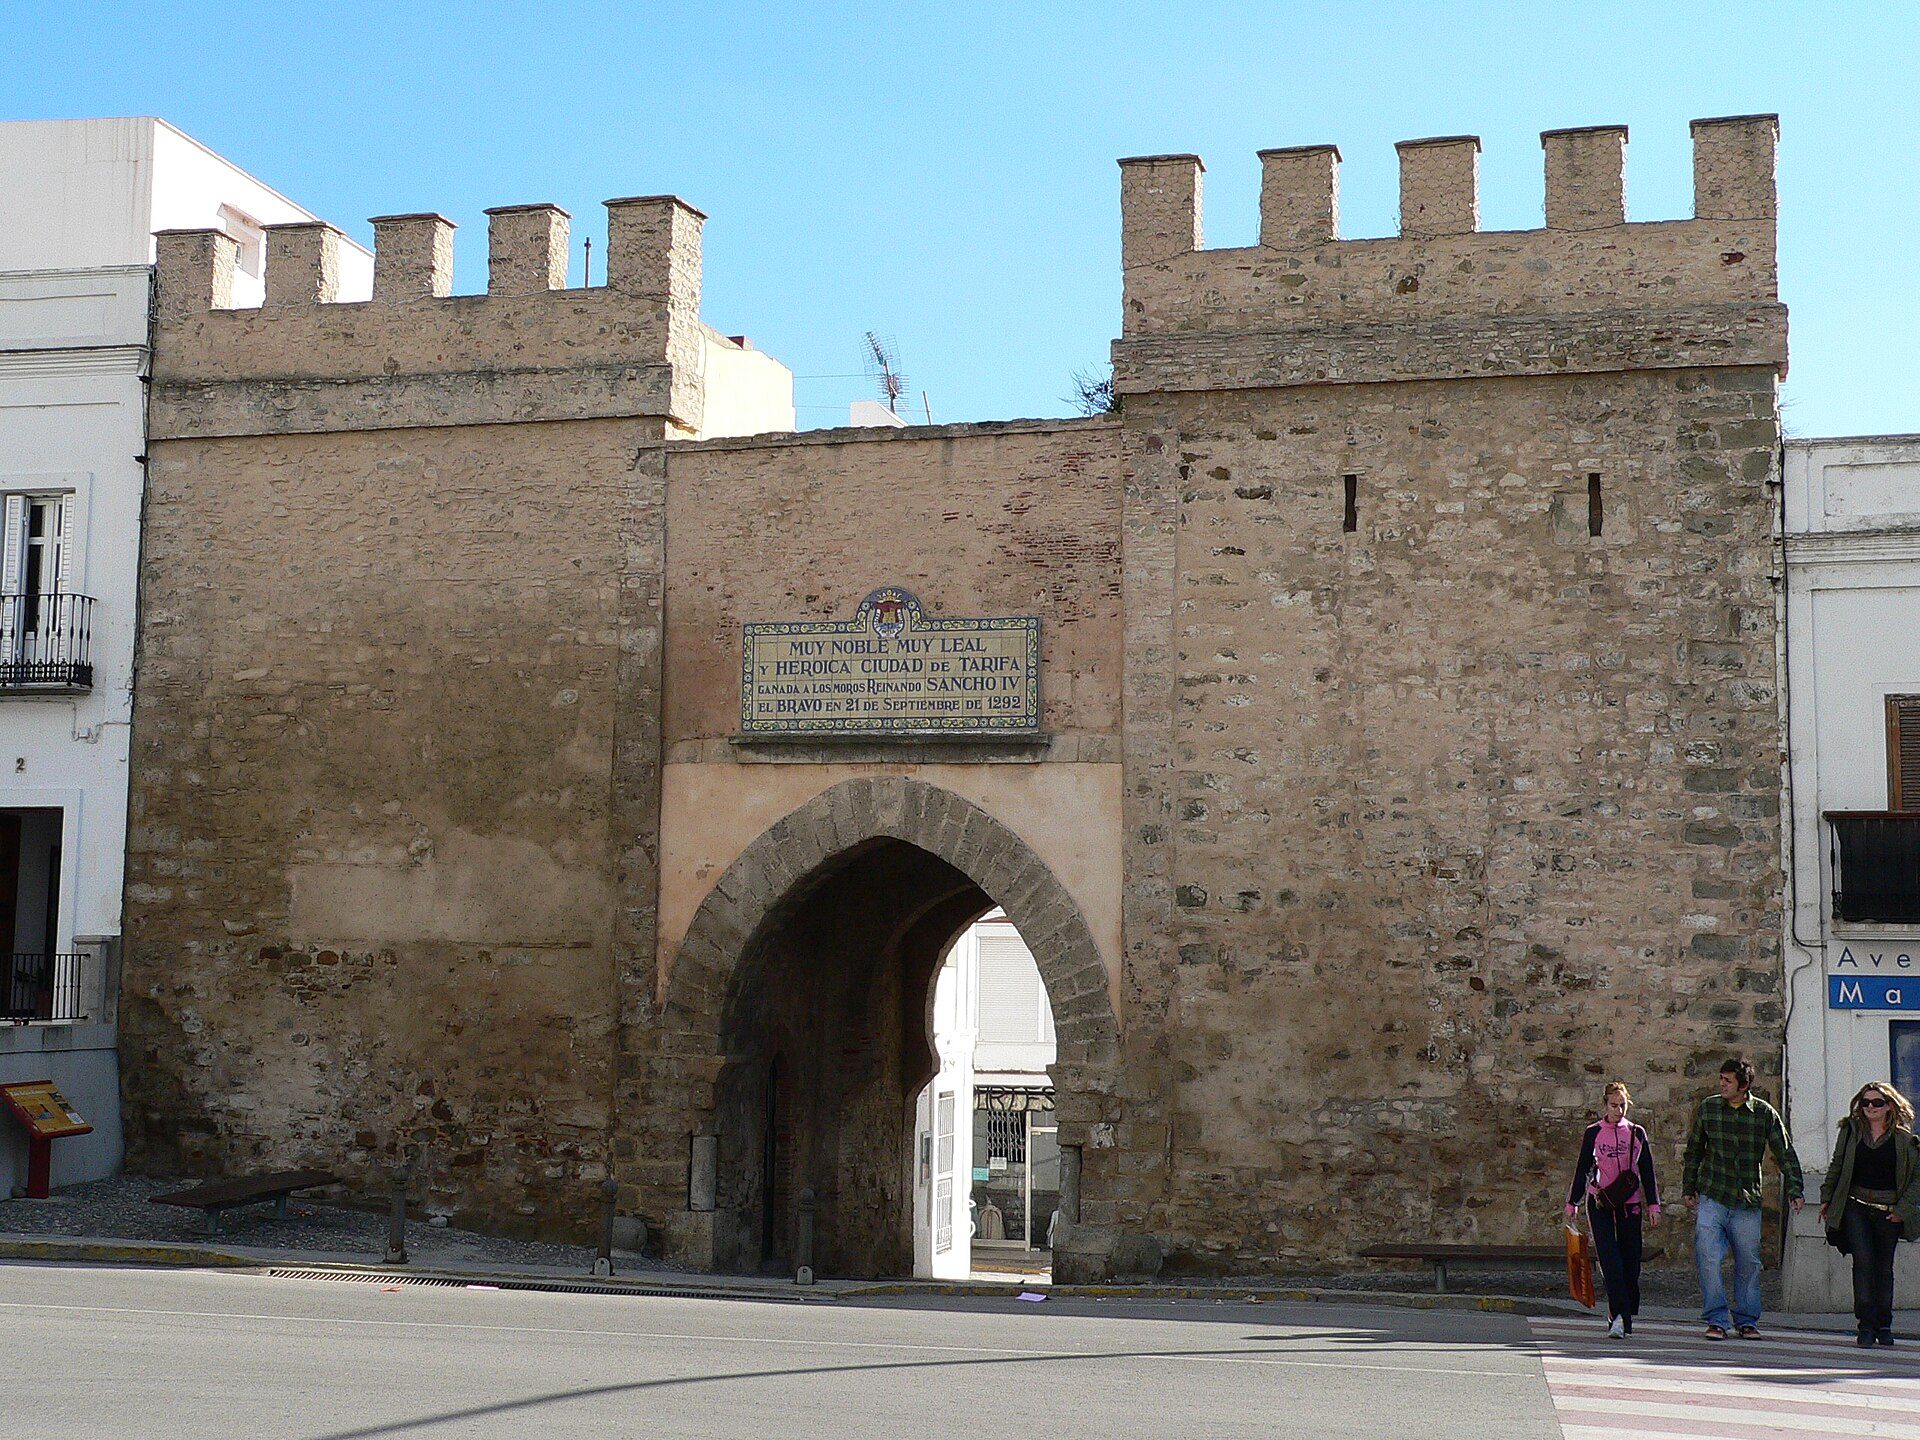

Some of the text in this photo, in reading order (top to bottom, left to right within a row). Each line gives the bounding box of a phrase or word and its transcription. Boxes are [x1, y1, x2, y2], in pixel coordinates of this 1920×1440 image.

[789, 637, 988, 656] MUY NOBLE MUY LEAL
[759, 656, 1020, 677] Y HEROICA CIUDAD DE TARIFA
[758, 676, 1021, 695] GANADA A LOS MOROS REINANDO SANCHO IV
[758, 695, 1021, 714] EL BRAVO EN 21 DE SEPTIEMBRE DE 1292
[15, 757, 26, 773] 2
